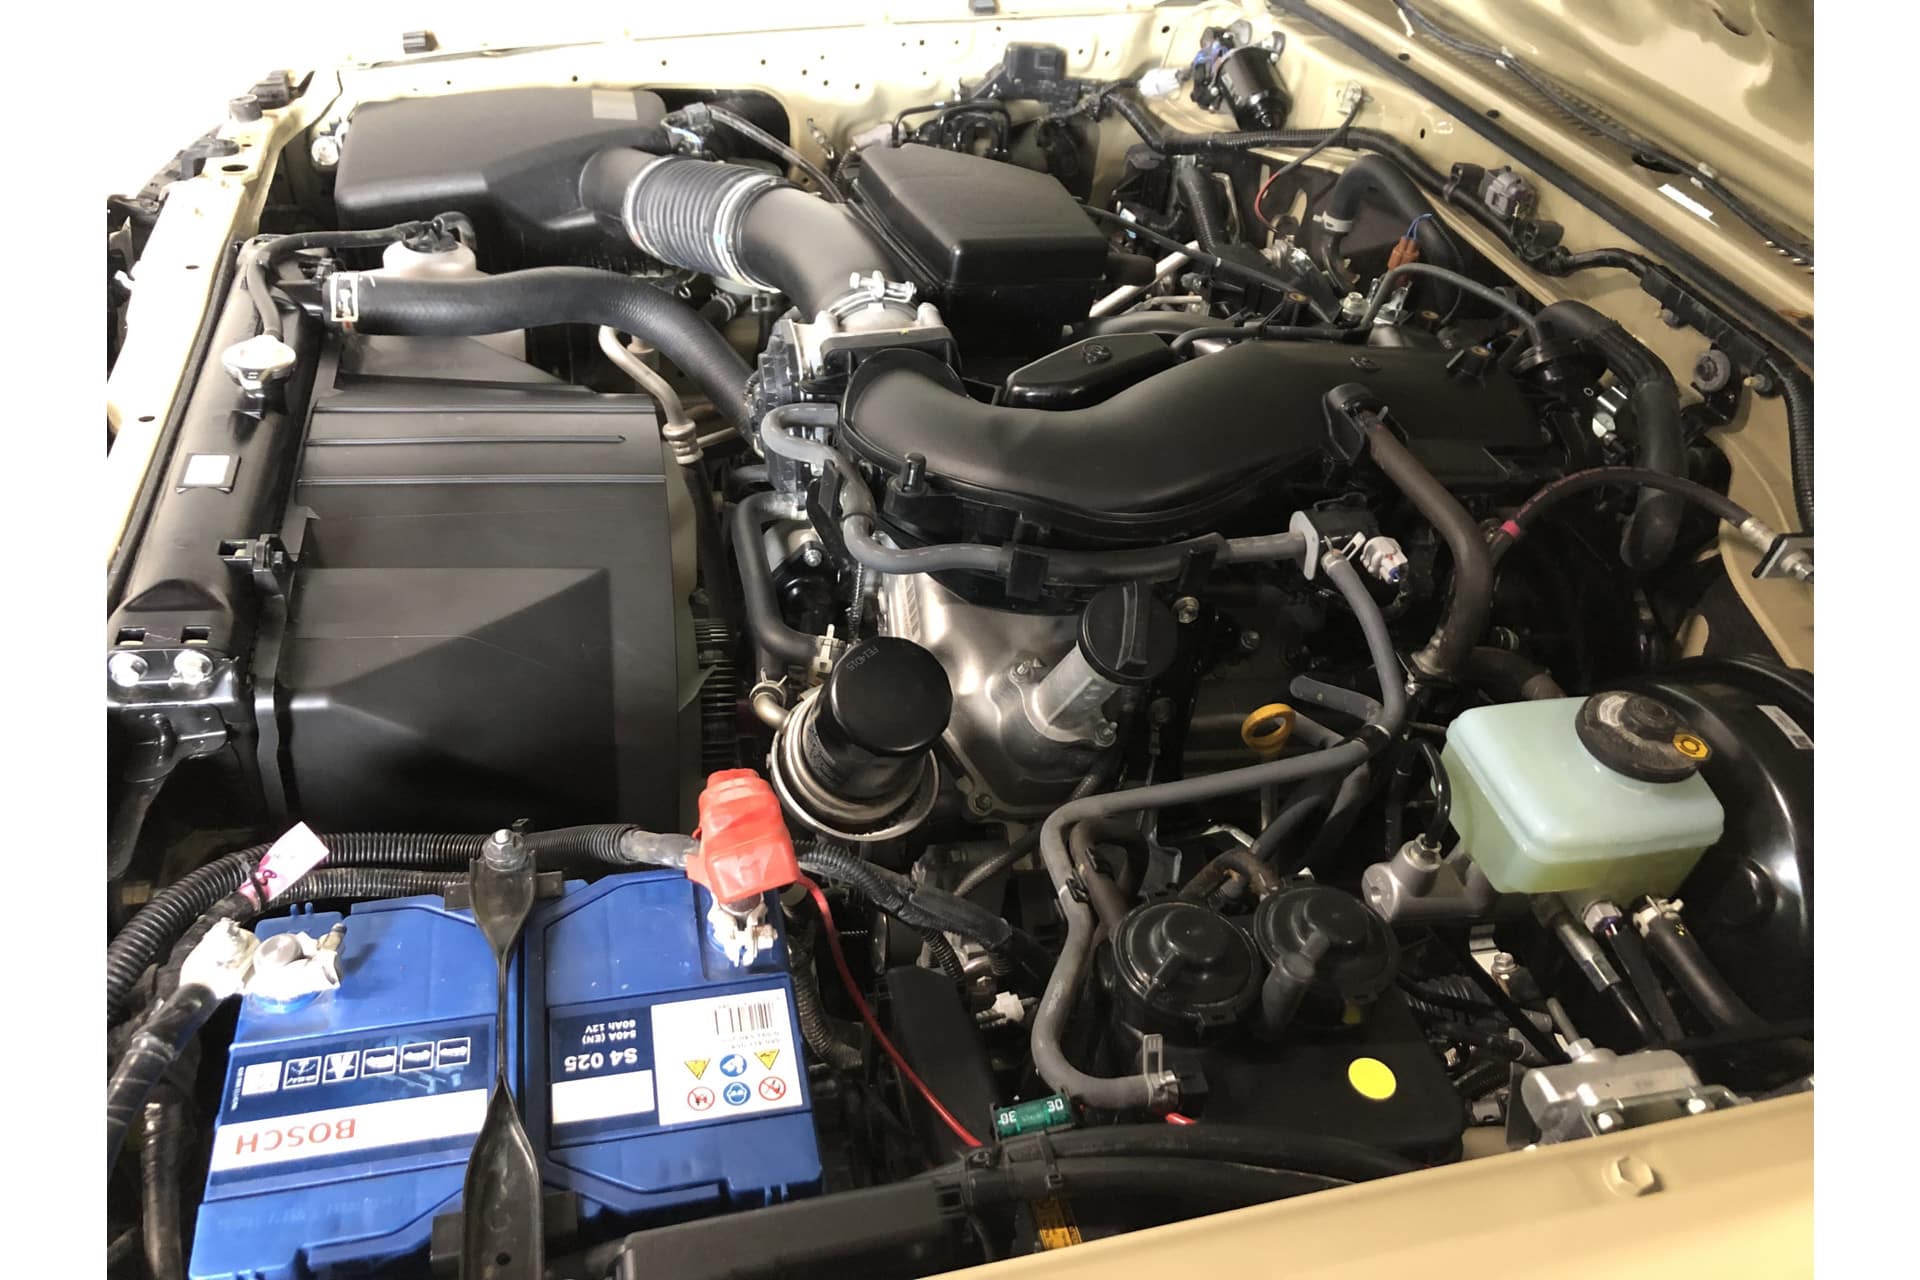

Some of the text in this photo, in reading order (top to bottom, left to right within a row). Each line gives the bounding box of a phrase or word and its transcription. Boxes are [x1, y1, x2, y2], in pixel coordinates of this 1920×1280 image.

[585, 1023, 605, 1034] 12V
[582, 1033, 606, 1045] (EN)
[564, 1047, 638, 1073] S4 025
[1046, 1098, 1064, 1113] 30
[235, 1118, 356, 1155] BOSCH
